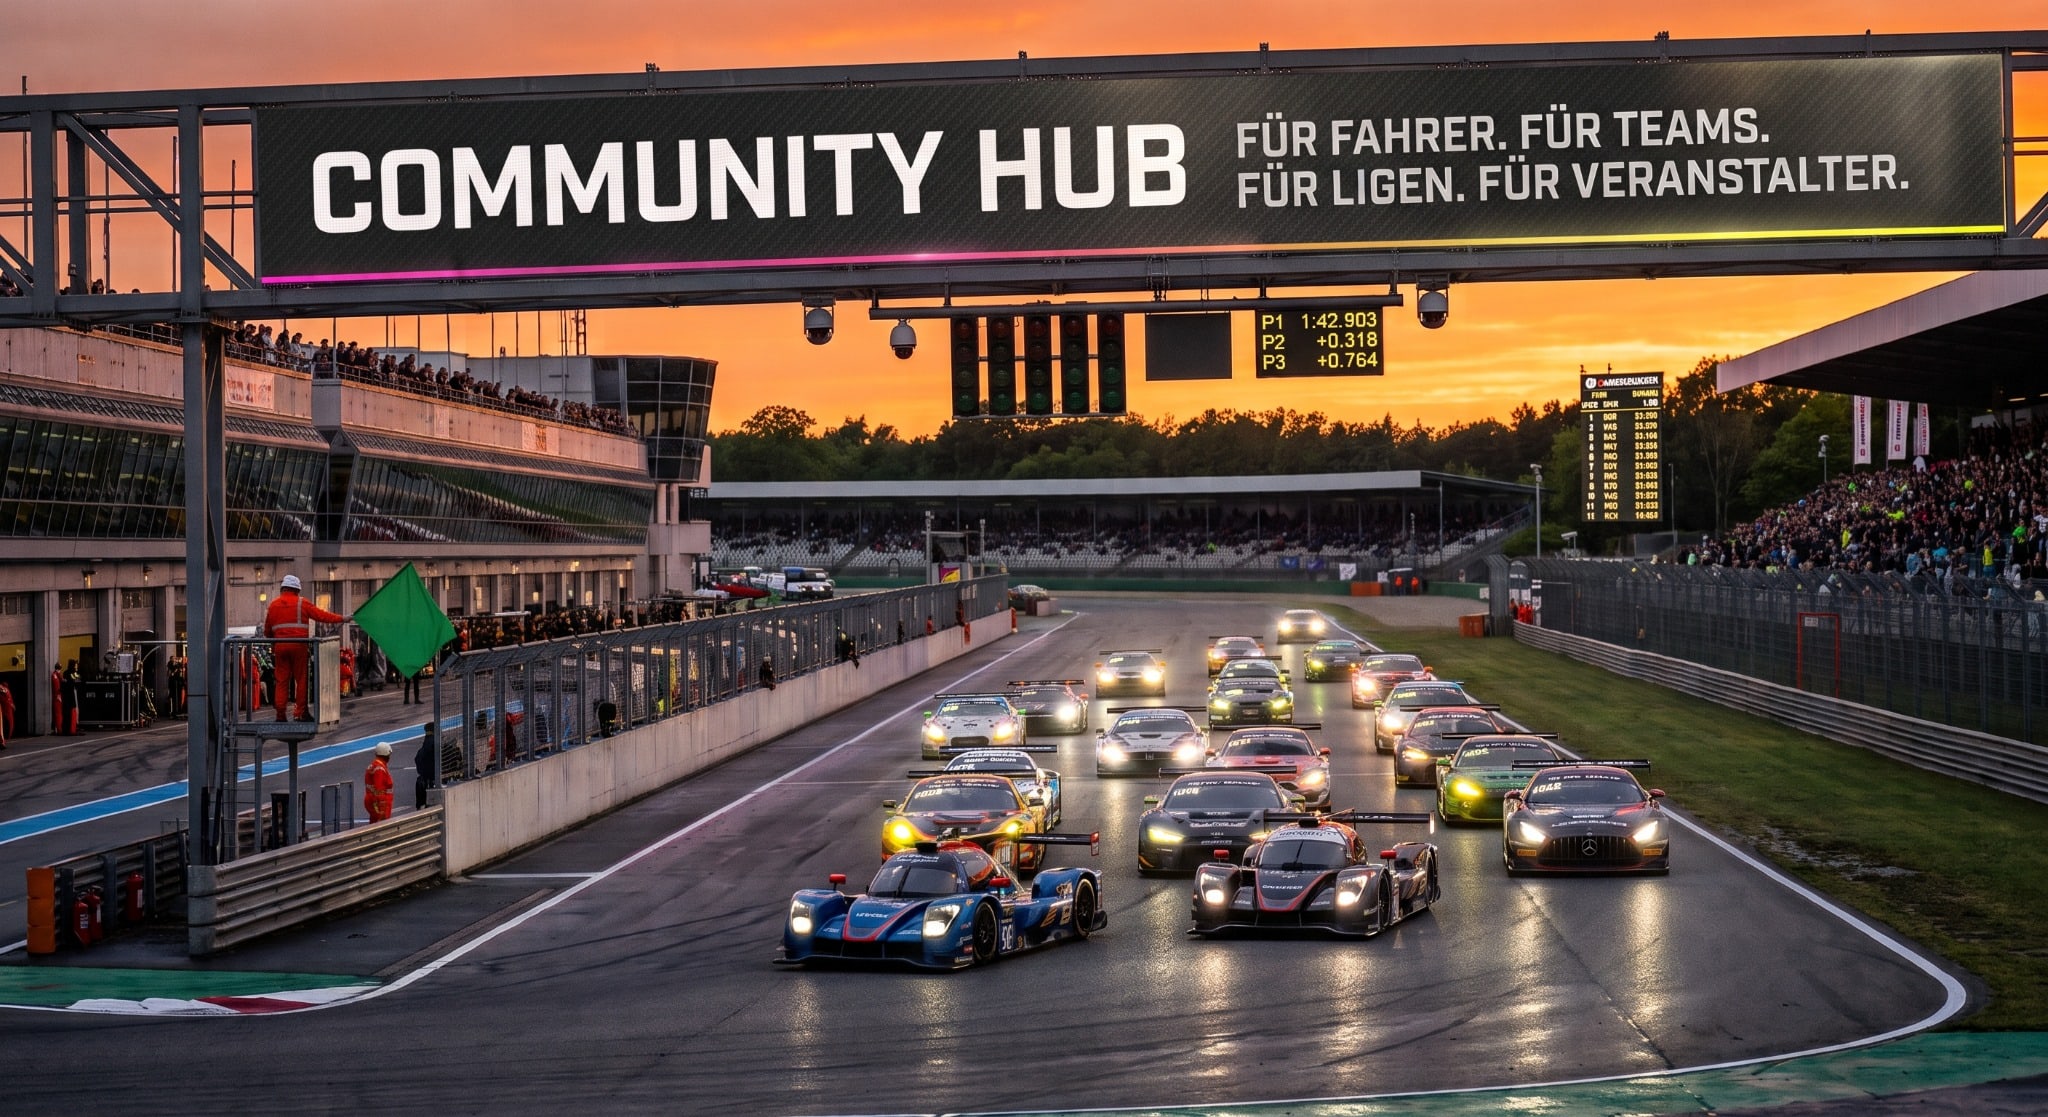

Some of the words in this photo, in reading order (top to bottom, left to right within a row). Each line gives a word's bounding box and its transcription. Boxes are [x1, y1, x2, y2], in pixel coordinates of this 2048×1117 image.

[1236, 111, 1317, 159] FÜR
[1331, 115, 1507, 156] FAHRER.
[1521, 103, 1602, 152] FÜR
[1613, 107, 1770, 148] TEAMS.
[312, 130, 944, 235] COMMUNITY
[979, 123, 1187, 212] HUB
[1237, 162, 1318, 209] FÜR
[1332, 166, 1465, 207] LIGEN.
[1479, 154, 1563, 202] FÜR
[1571, 155, 1909, 200] VERANSTALTER.
[1262, 314, 1282, 330] P1
[1302, 312, 1376, 329] 1:42.903
[1262, 335, 1285, 350] P2
[1317, 332, 1377, 348] +0.318
[1263, 355, 1285, 370] P3
[1318, 352, 1378, 368] +0.764
